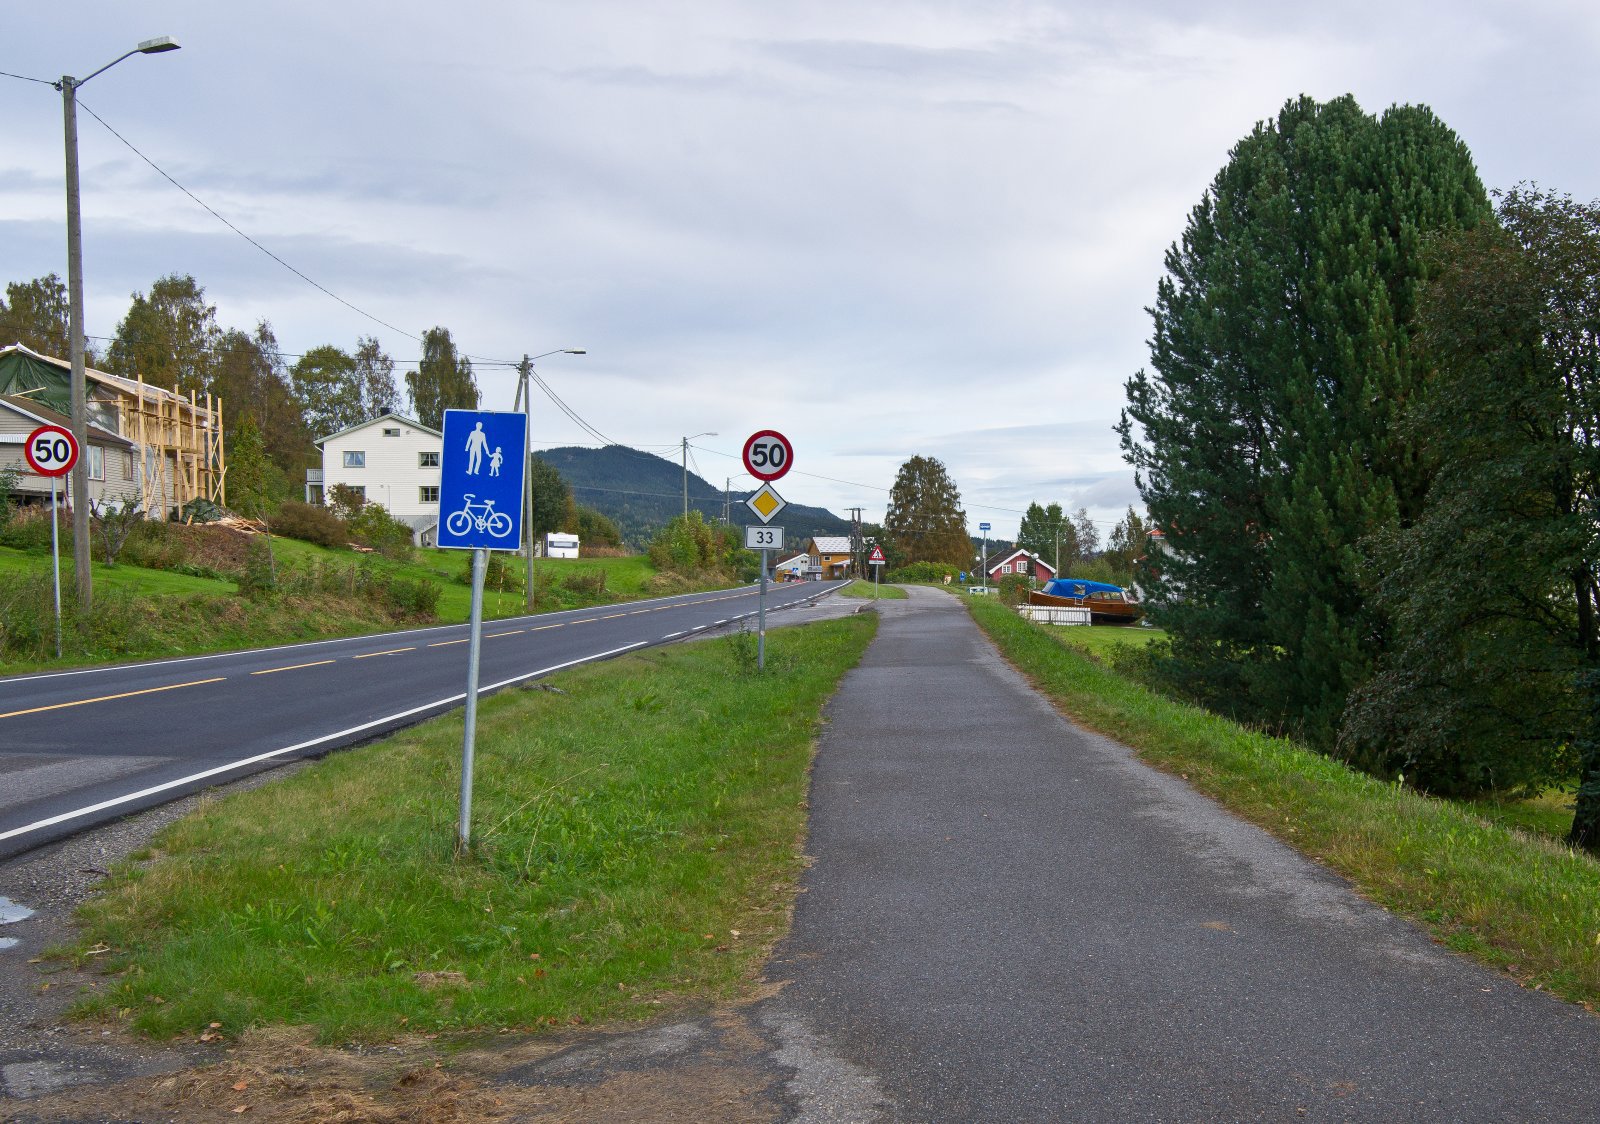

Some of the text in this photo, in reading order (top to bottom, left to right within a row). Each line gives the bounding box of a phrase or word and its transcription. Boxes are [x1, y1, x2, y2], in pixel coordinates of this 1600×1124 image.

[35, 439, 70, 463] 50
[751, 443, 785, 468] 50
[756, 531, 774, 544] 33
